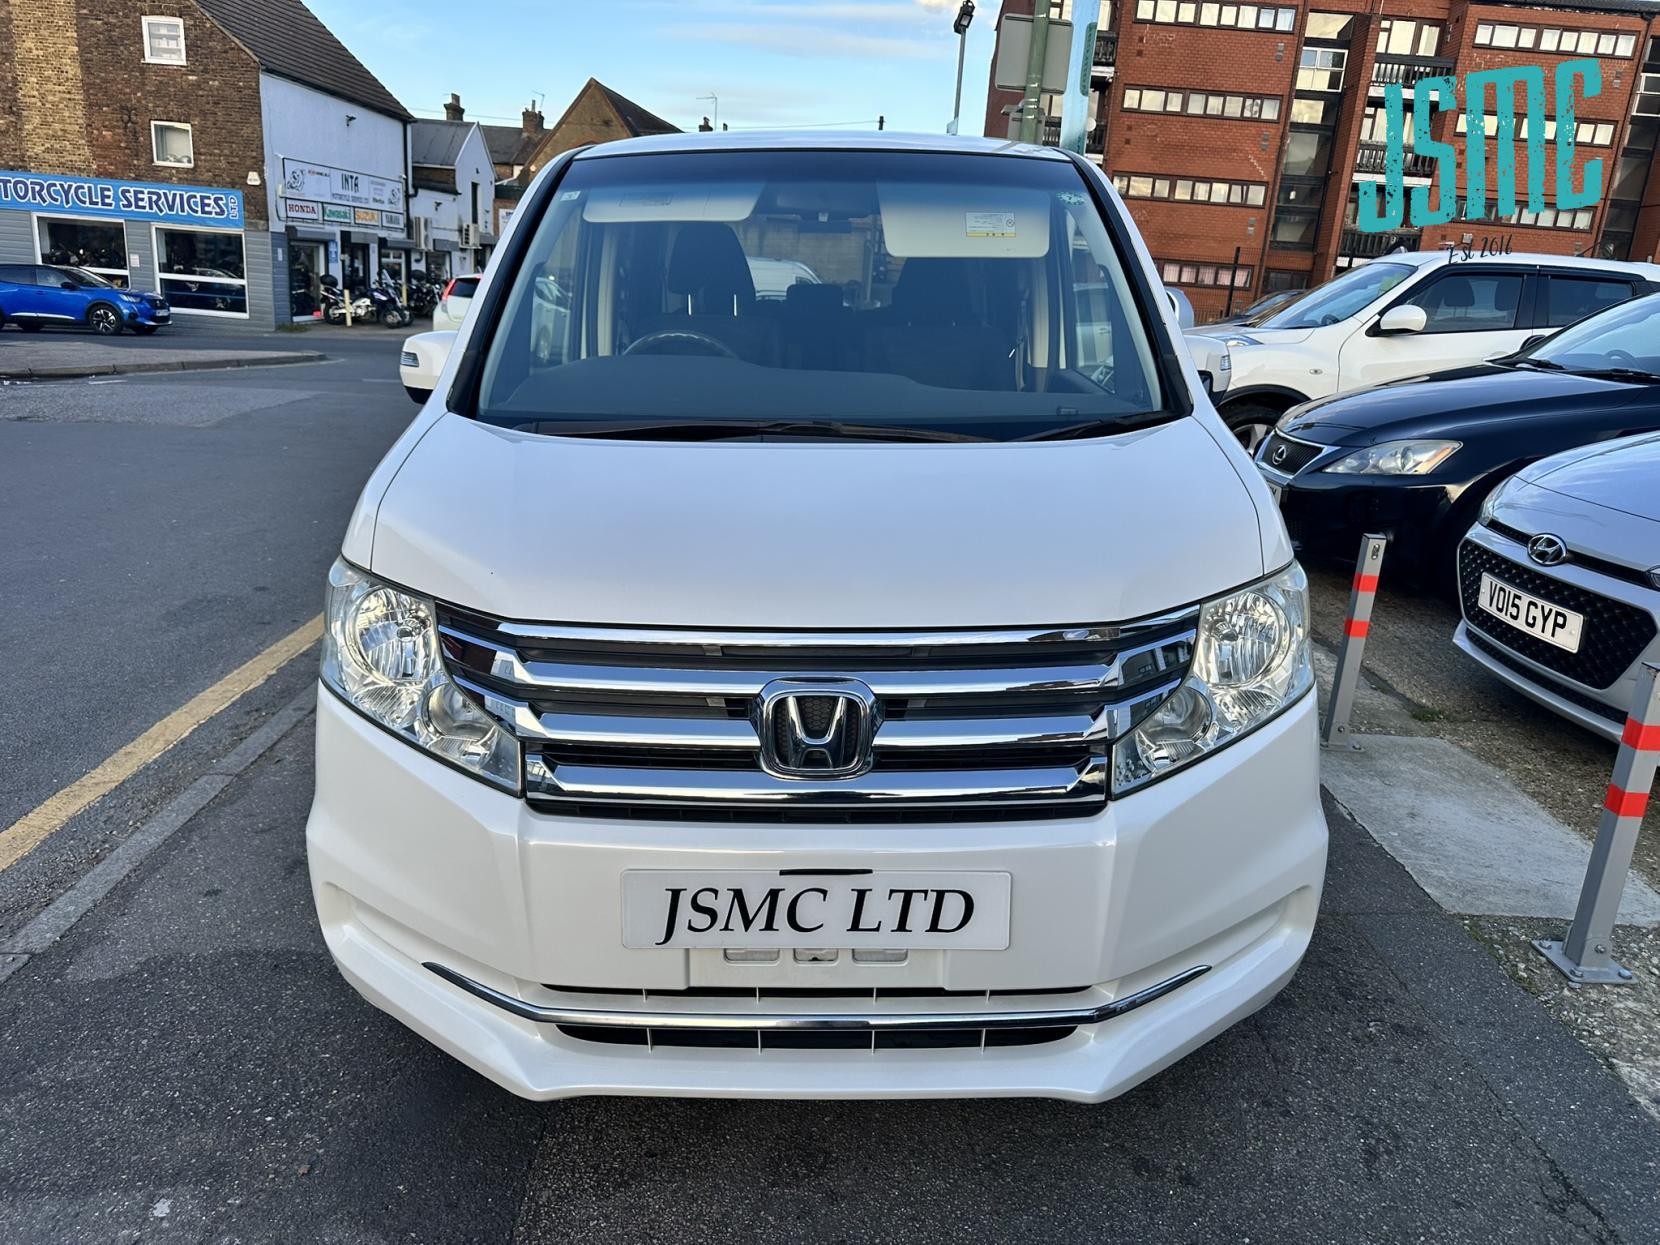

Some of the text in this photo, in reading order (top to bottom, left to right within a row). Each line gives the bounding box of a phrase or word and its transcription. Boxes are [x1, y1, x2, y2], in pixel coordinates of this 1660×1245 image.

[0, 177, 228, 218] TORCYCLE SERVICES
[228, 196, 239, 220] LTD
[288, 203, 317, 215] HONDA
[1525, 600, 1568, 638] GYP
[654, 887, 975, 945] JSMC LTD
